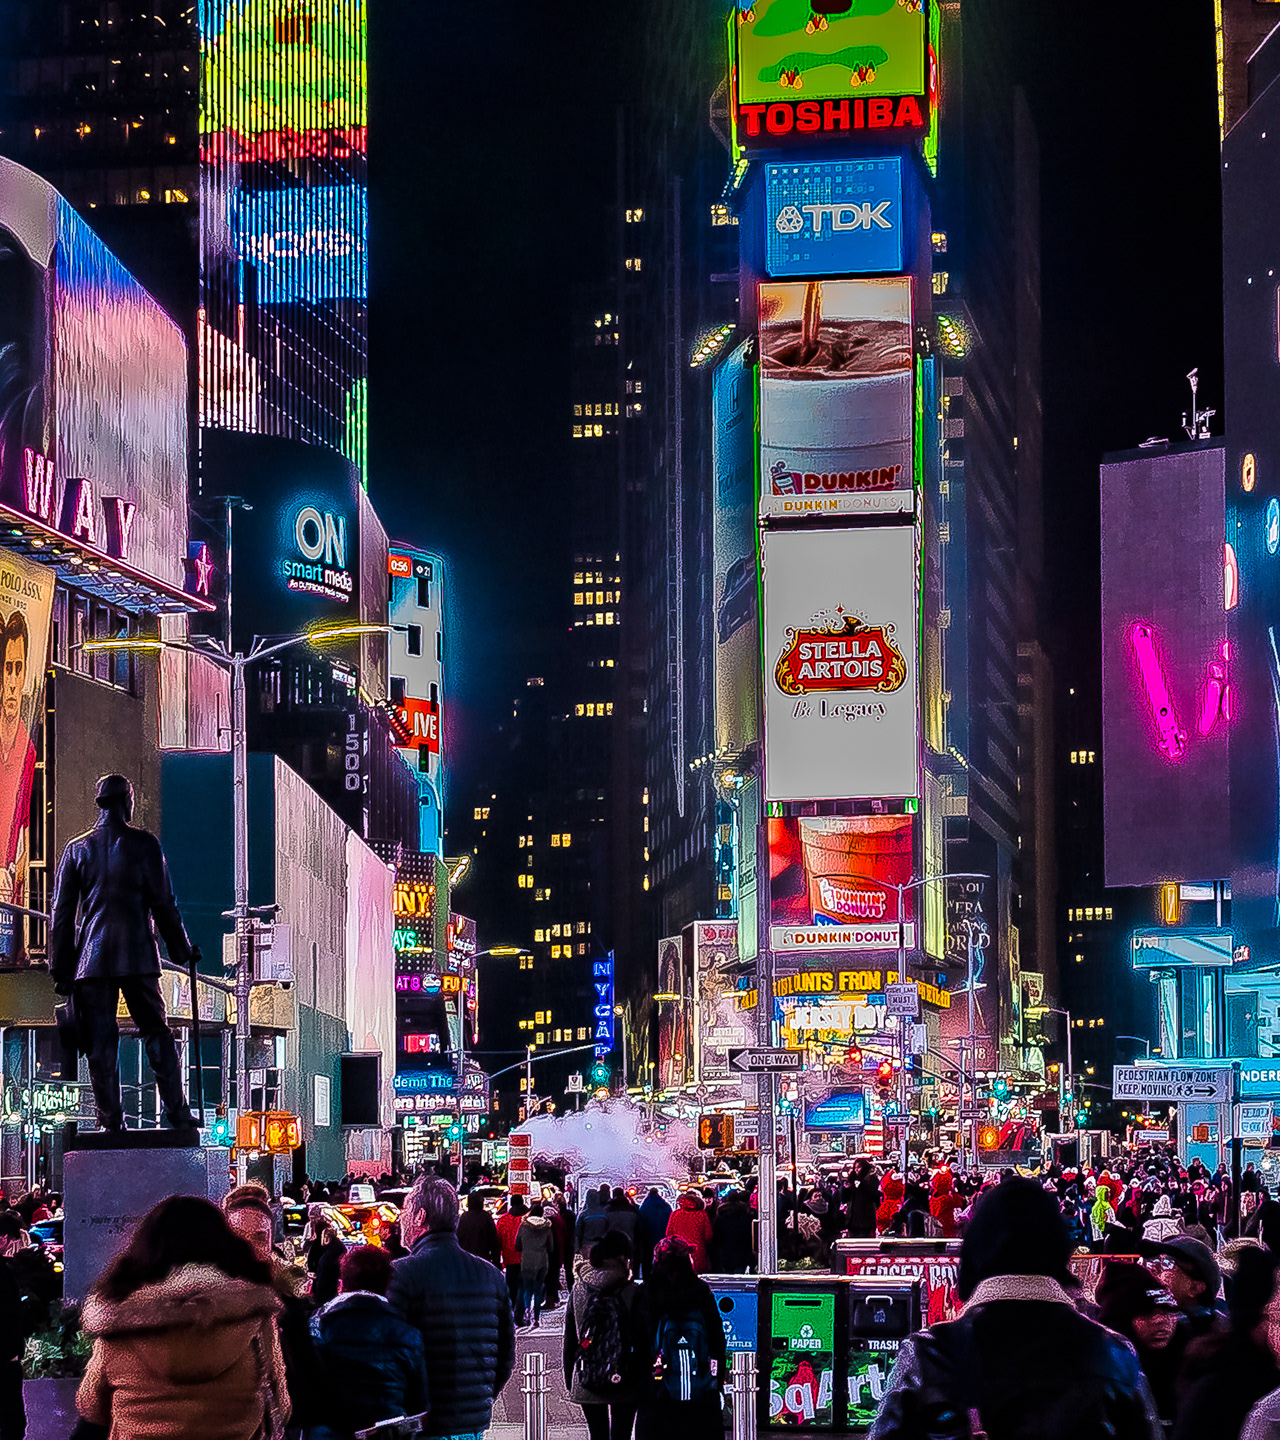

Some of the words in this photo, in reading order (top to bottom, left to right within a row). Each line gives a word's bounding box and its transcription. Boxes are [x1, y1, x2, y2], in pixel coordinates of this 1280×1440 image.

[739, 96, 924, 136] TOSHIBA
[803, 201, 894, 232] TDK
[843, 496, 898, 510] DONUTS
[295, 506, 347, 569] ON
[1, 569, 22, 593] POLO
[283, 559, 323, 583] smart
[324, 567, 353, 592] media
[798, 639, 882, 661] STELLA
[797, 657, 883, 682] ARTOIS
[819, 696, 886, 721] Legacy
[345, 712, 361, 792] 1500
[838, 970, 882, 991] FROM
[790, 1006, 852, 1030] JERSEY
[853, 1005, 898, 1030] BOYS
[750, 1054, 771, 1066] ONE
[773, 1054, 797, 1066] WAY
[1118, 1070, 1169, 1082] PEDESTRIAN
[1170, 1071, 1195, 1083] FLOW
[1196, 1071, 1217, 1083] ZONE
[1118, 1083, 1140, 1095] KEEP
[1141, 1084, 1173, 1096] MOVING
[790, 1338, 822, 1350] PAPER
[868, 1339, 900, 1351] TRASH
